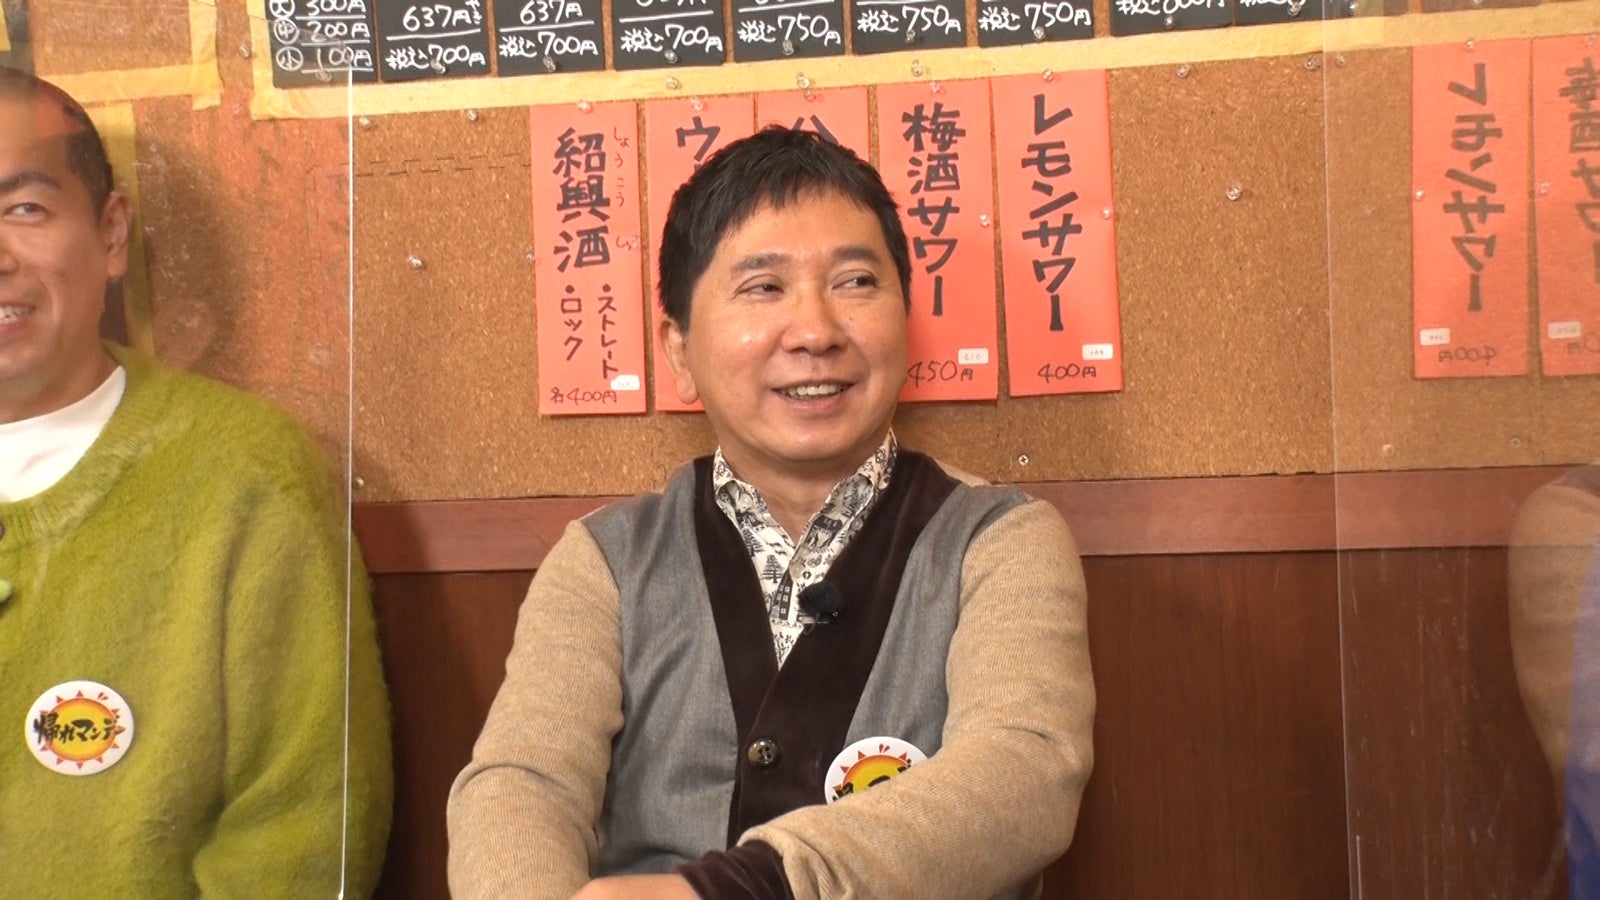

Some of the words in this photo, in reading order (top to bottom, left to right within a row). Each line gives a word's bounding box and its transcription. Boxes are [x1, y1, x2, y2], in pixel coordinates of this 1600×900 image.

[403, 4, 472, 31] 637円
[520, 0, 583, 25] 637円
[857, 5, 961, 35] 税込750円
[977, 2, 1092, 31] 税込750円
[306, 20, 370, 42] 200円
[499, 31, 599, 58] 税込700円
[620, 23, 723, 53] 税込700円
[737, 13, 841, 47] 税込750円
[317, 46, 373, 69] 100円
[385, 43, 486, 70] 税込700円
[552, 126, 611, 273] 紹興酒
[902, 102, 967, 317] 梅酒サワー
[1021, 93, 1083, 332] レモンサワー
[907, 360, 974, 389] 450円
[1037, 363, 1098, 384] 400円
